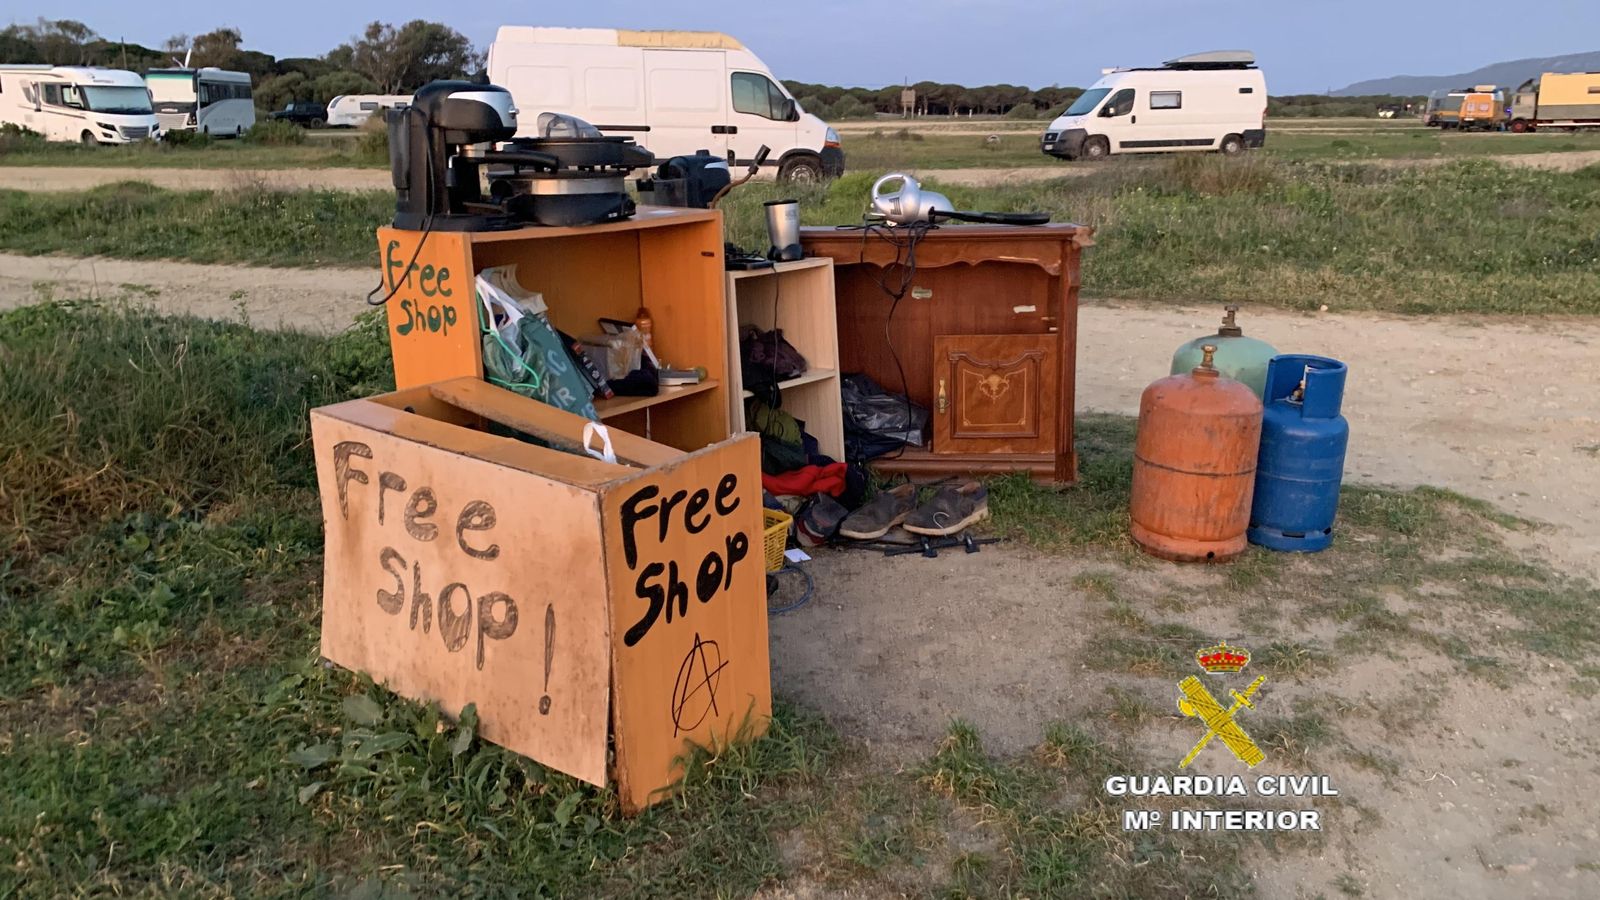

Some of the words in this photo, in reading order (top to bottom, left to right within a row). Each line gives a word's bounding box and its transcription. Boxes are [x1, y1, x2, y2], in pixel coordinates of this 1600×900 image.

[387, 240, 453, 298] Free
[396, 299, 457, 337] Shop
[333, 441, 501, 561] Free
[620, 473, 741, 570] Free
[623, 531, 749, 648] Shop
